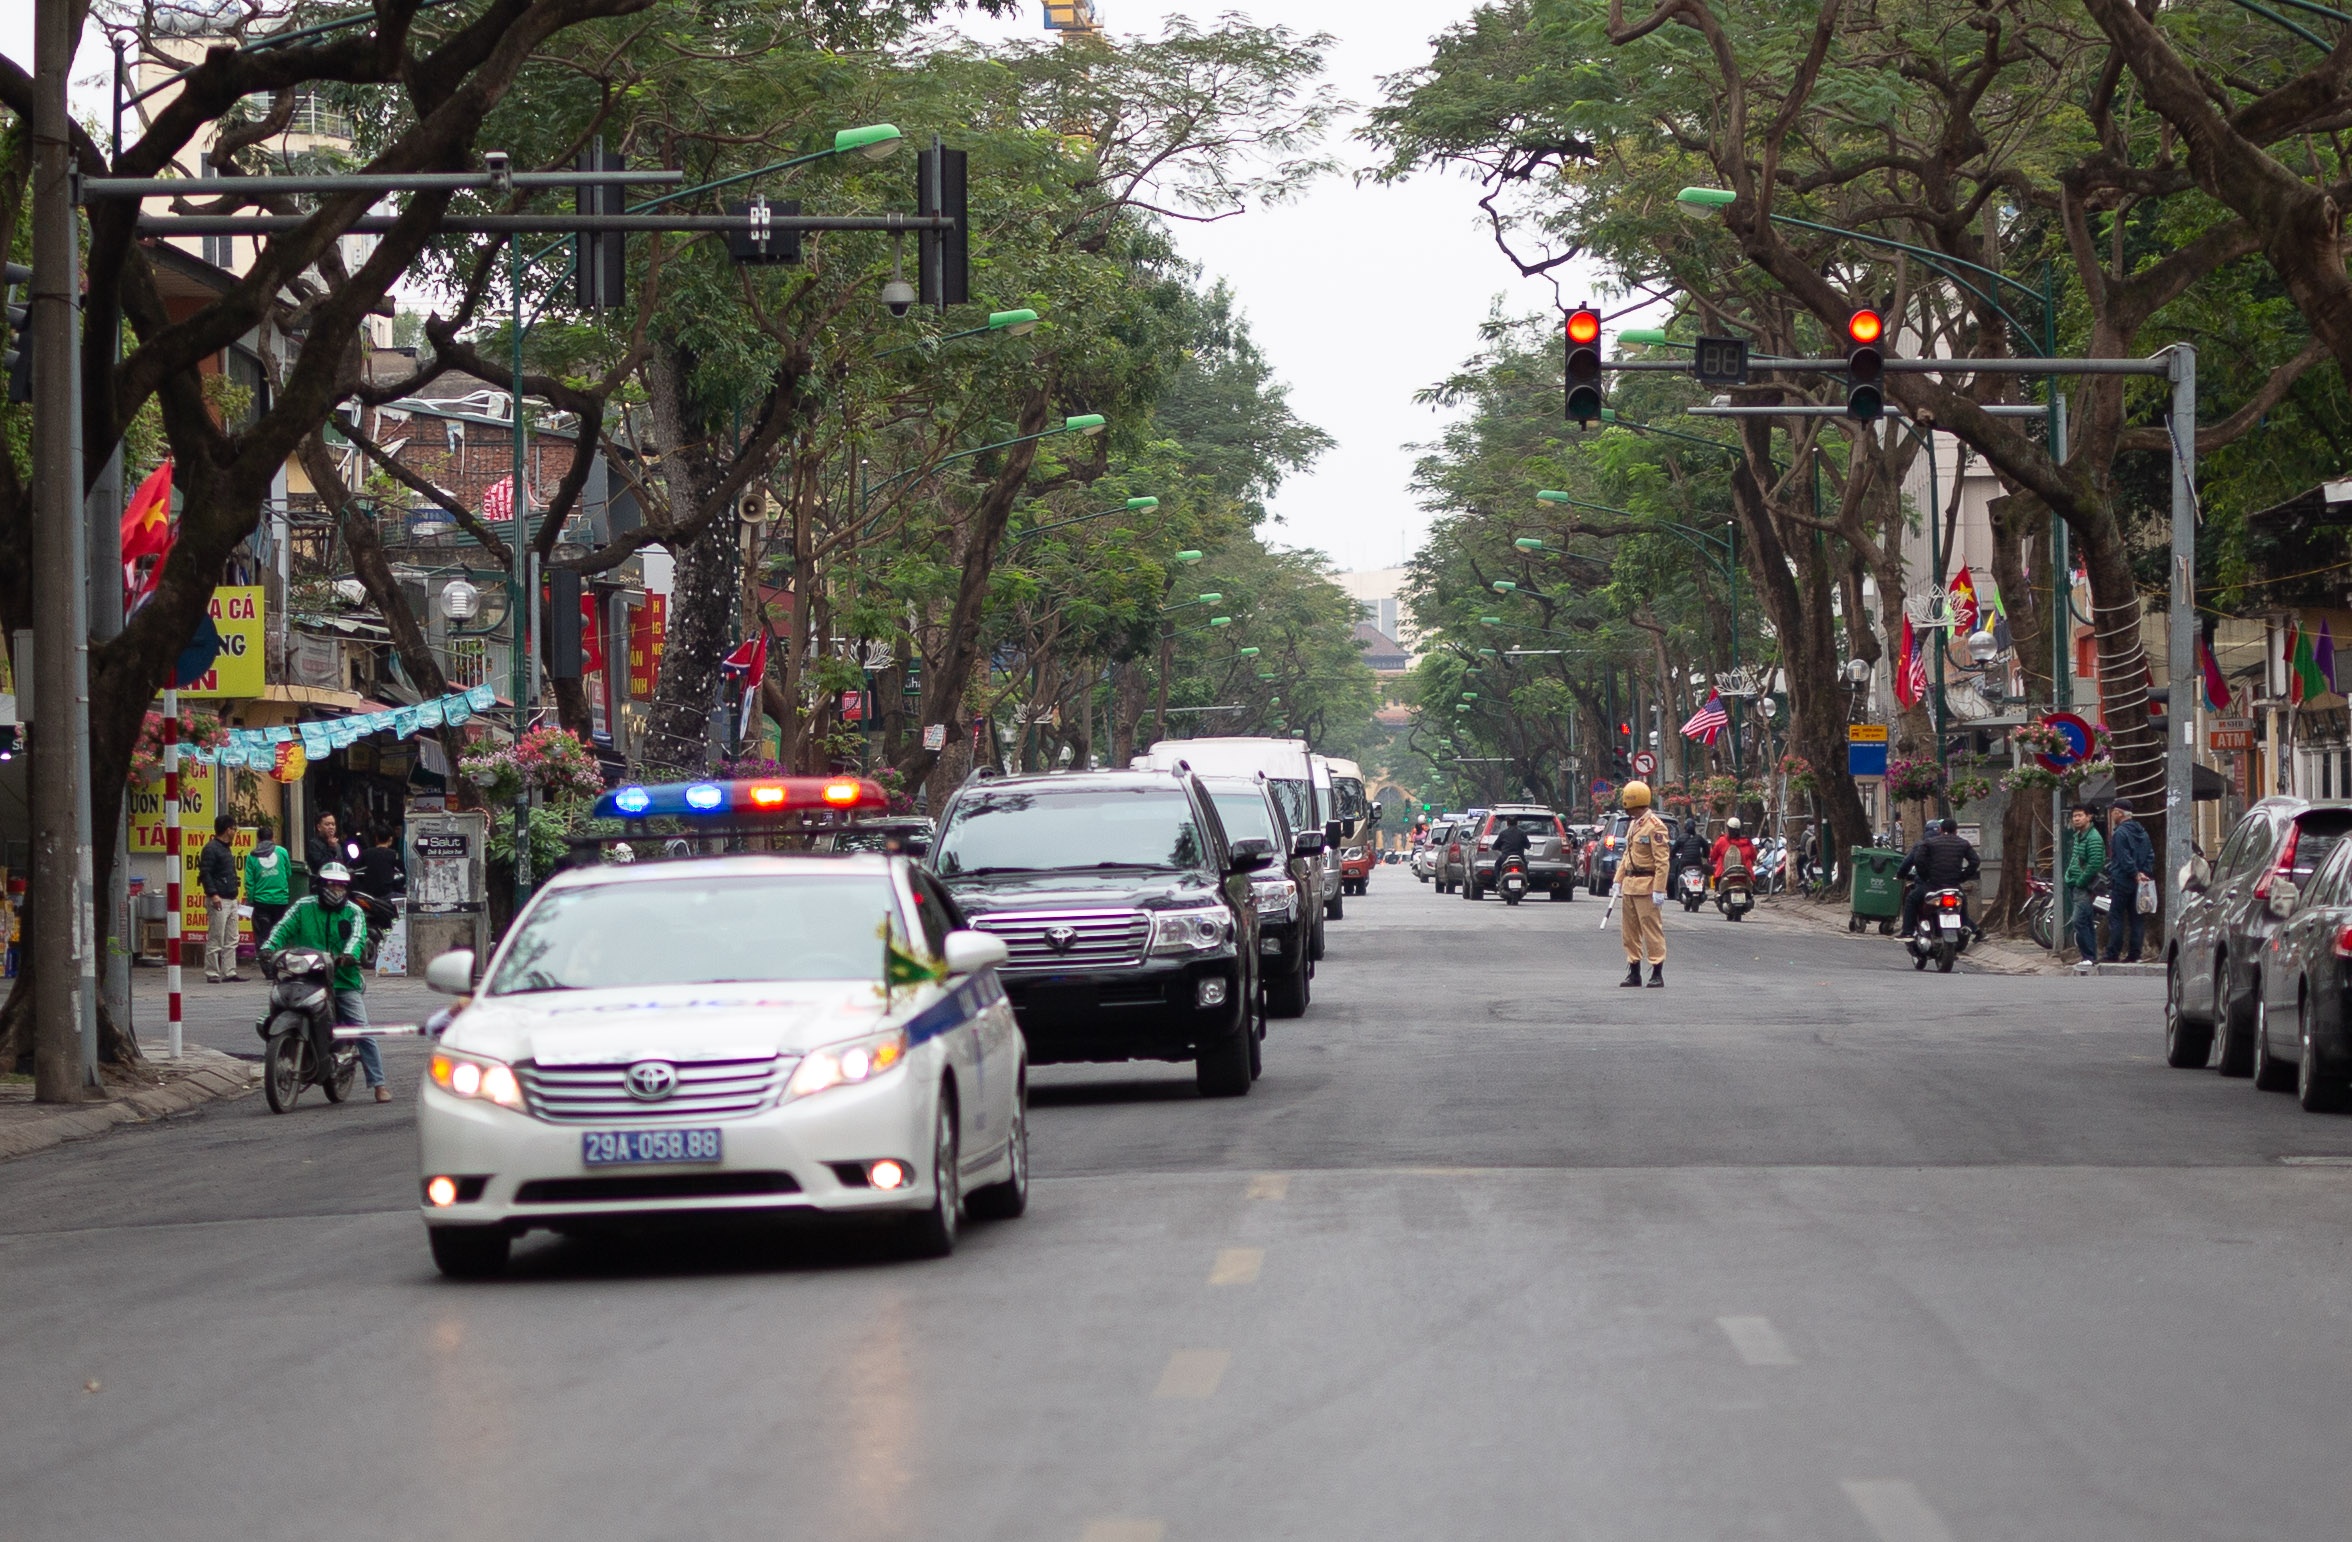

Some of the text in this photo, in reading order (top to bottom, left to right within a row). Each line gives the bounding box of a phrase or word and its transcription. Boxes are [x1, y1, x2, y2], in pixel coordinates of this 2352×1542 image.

[229, 593, 255, 619] CÁ
[2218, 733, 2246, 747] ATM
[430, 837, 460, 847] Salut
[587, 1130, 718, 1161] 29A-058.88
